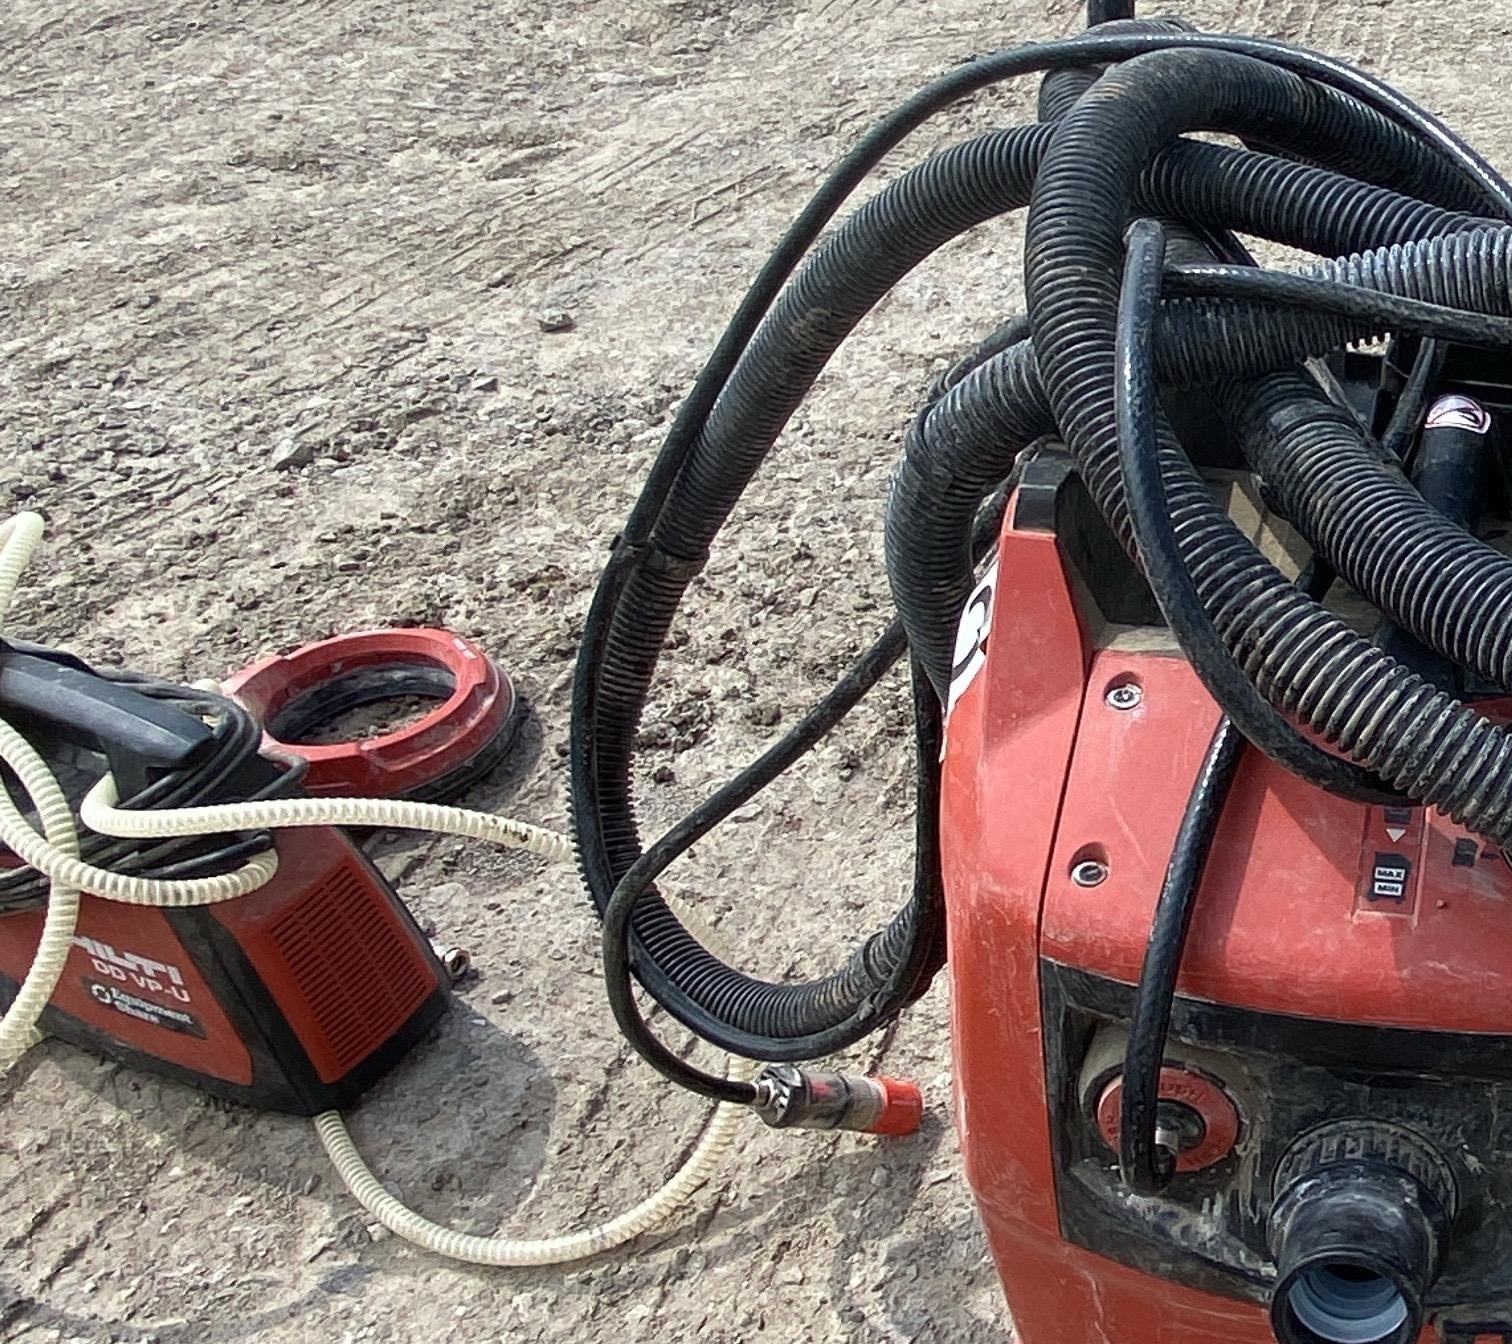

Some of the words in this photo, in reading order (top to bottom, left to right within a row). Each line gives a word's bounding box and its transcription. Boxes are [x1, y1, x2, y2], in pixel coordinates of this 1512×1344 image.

[1376, 869, 1402, 878] MAX
[1377, 884, 1399, 893] MIN
[91, 958, 127, 981] DD
[129, 971, 192, 1003] VP-U
